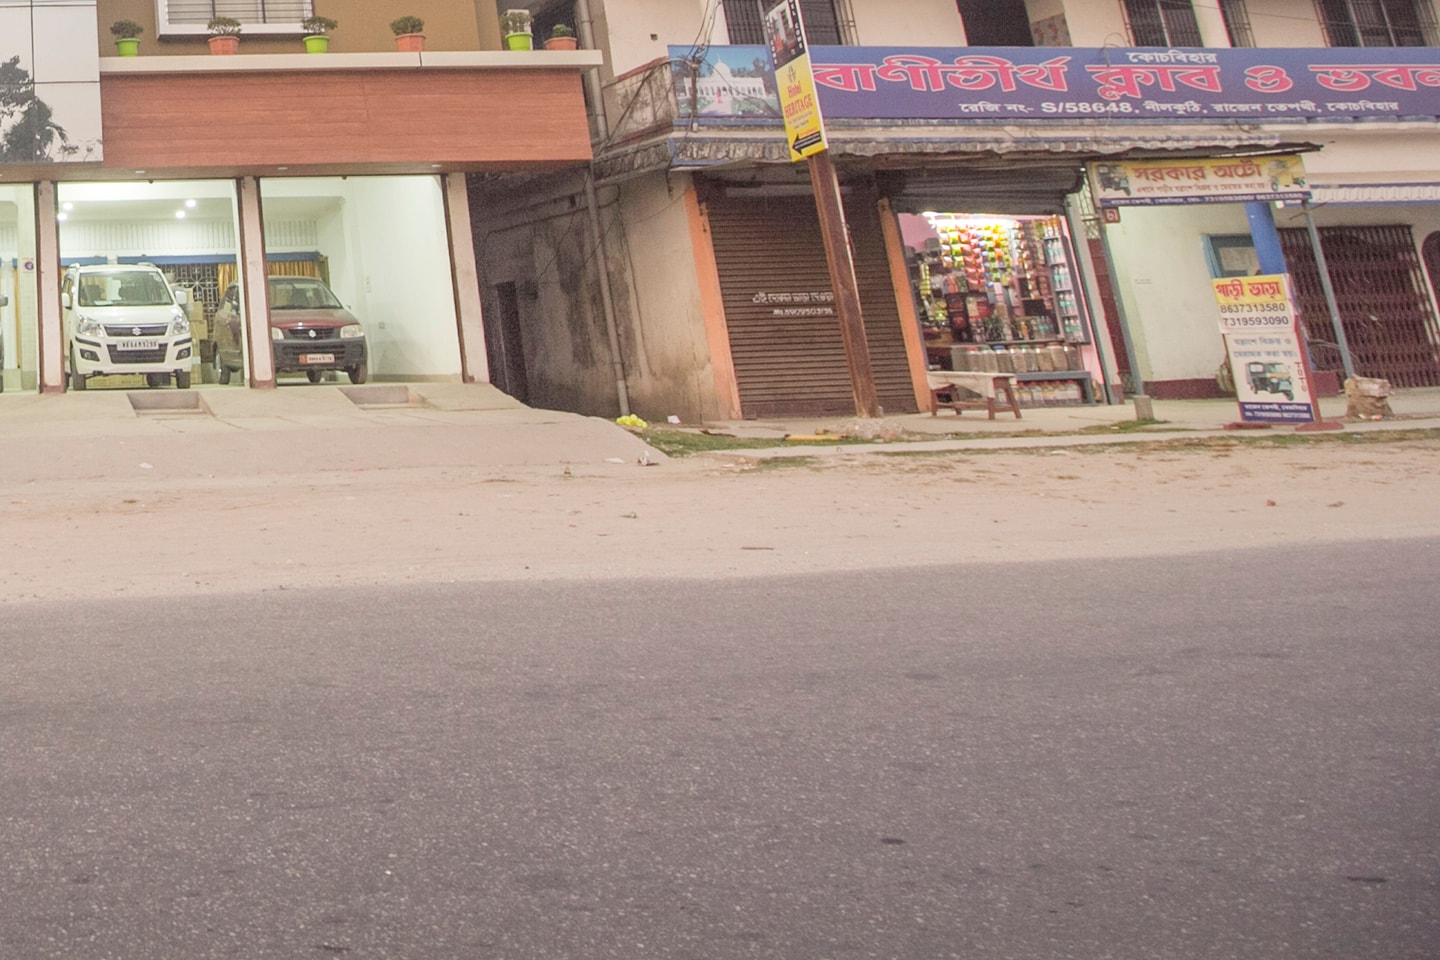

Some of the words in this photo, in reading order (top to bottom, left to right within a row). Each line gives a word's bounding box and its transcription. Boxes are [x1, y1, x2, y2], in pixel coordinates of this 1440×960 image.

[1126, 50, 1218, 64] কোচবিহার
[811, 55, 1072, 92] বাণীতীর্থ
[1085, 65, 1222, 100] ক্লাব
[1244, 65, 1294, 93] ও
[1131, 165, 1206, 182] সরকার
[1247, 281, 1281, 299] ভাড়া
[1220, 303, 1286, 314] 8637313580
[1223, 316, 1289, 326] 7319593090
